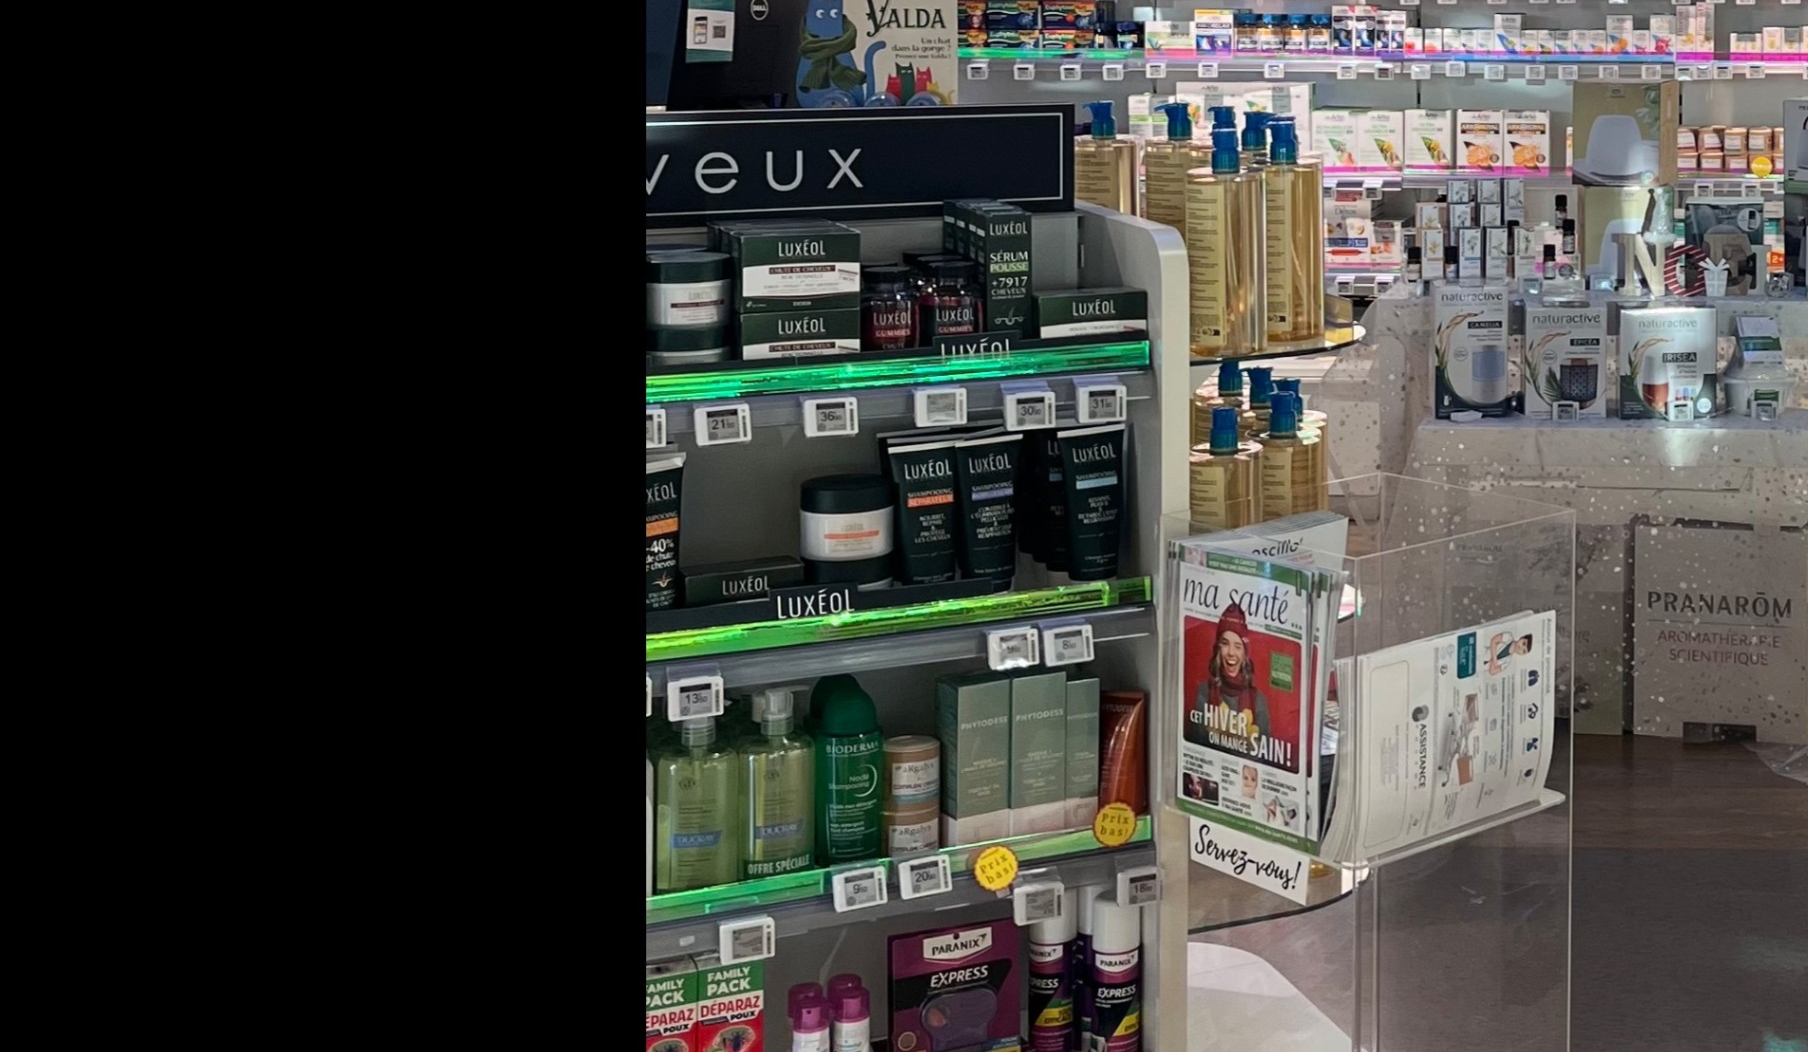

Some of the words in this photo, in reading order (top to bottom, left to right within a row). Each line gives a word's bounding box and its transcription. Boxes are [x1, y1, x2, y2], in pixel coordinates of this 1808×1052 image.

[989, 220, 1028, 236] LUXÉOL
[778, 240, 826, 257] LUXÉOL
[989, 250, 1029, 262] SÉRUM
[989, 262, 1029, 272] POUSSE
[991, 276, 1028, 287] +7917
[991, 287, 1027, 297] CHEVEUX
[1441, 291, 1503, 302] naturactive
[936, 304, 974, 322] LUXÉOL
[1072, 299, 1116, 316] LUXÉOL
[873, 307, 911, 326] LUXÉOL
[1532, 313, 1600, 325] naturactive
[1638, 318, 1698, 328] naturactive
[778, 317, 826, 335] LUXÉOL
[875, 329, 911, 338] GUMMIES
[938, 324, 974, 333] GUMMIES
[1072, 443, 1116, 463] LUXÉOL
[904, 459, 952, 480] LUXÉOL
[968, 453, 1012, 474] LUXÉOL
[646, 481, 678, 504] XÉOL
[722, 576, 770, 596] LUXÉOL
[777, 588, 855, 619] LUXÉOL
[1184, 578, 1220, 609] ma
[1229, 585, 1290, 625] santé
[1669, 649, 1769, 666] SCIENTIFIQUE
[1016, 708, 1064, 722] PHYTODESS
[1190, 709, 1203, 724] CET
[1204, 703, 1248, 737] HIVER
[1208, 731, 1220, 746] ON
[1220, 733, 1248, 754] MANGE
[1418, 723, 1430, 789] ASSISTANCE
[1101, 813, 1129, 825] Prix
[1101, 825, 1128, 837] bas!
[747, 859, 774, 875] OFFRE
[775, 853, 810, 872] SPÉCIALE
[979, 854, 1009, 875] Prix
[986, 864, 1014, 884] bas!
[932, 938, 980, 956] PARANIX
[1100, 957, 1131, 967] PARANIX
[708, 966, 751, 982] FAMILY
[930, 965, 989, 988] EXPRESS
[646, 979, 685, 994] AMILY
[707, 978, 751, 996] PACK
[1098, 984, 1136, 998] EXPRESS
[700, 995, 760, 1018] DÉPARAZ
[646, 1008, 694, 1029] ÉPARAZ
[730, 1011, 756, 1021] POUX
[663, 1023, 689, 1034] POUX
